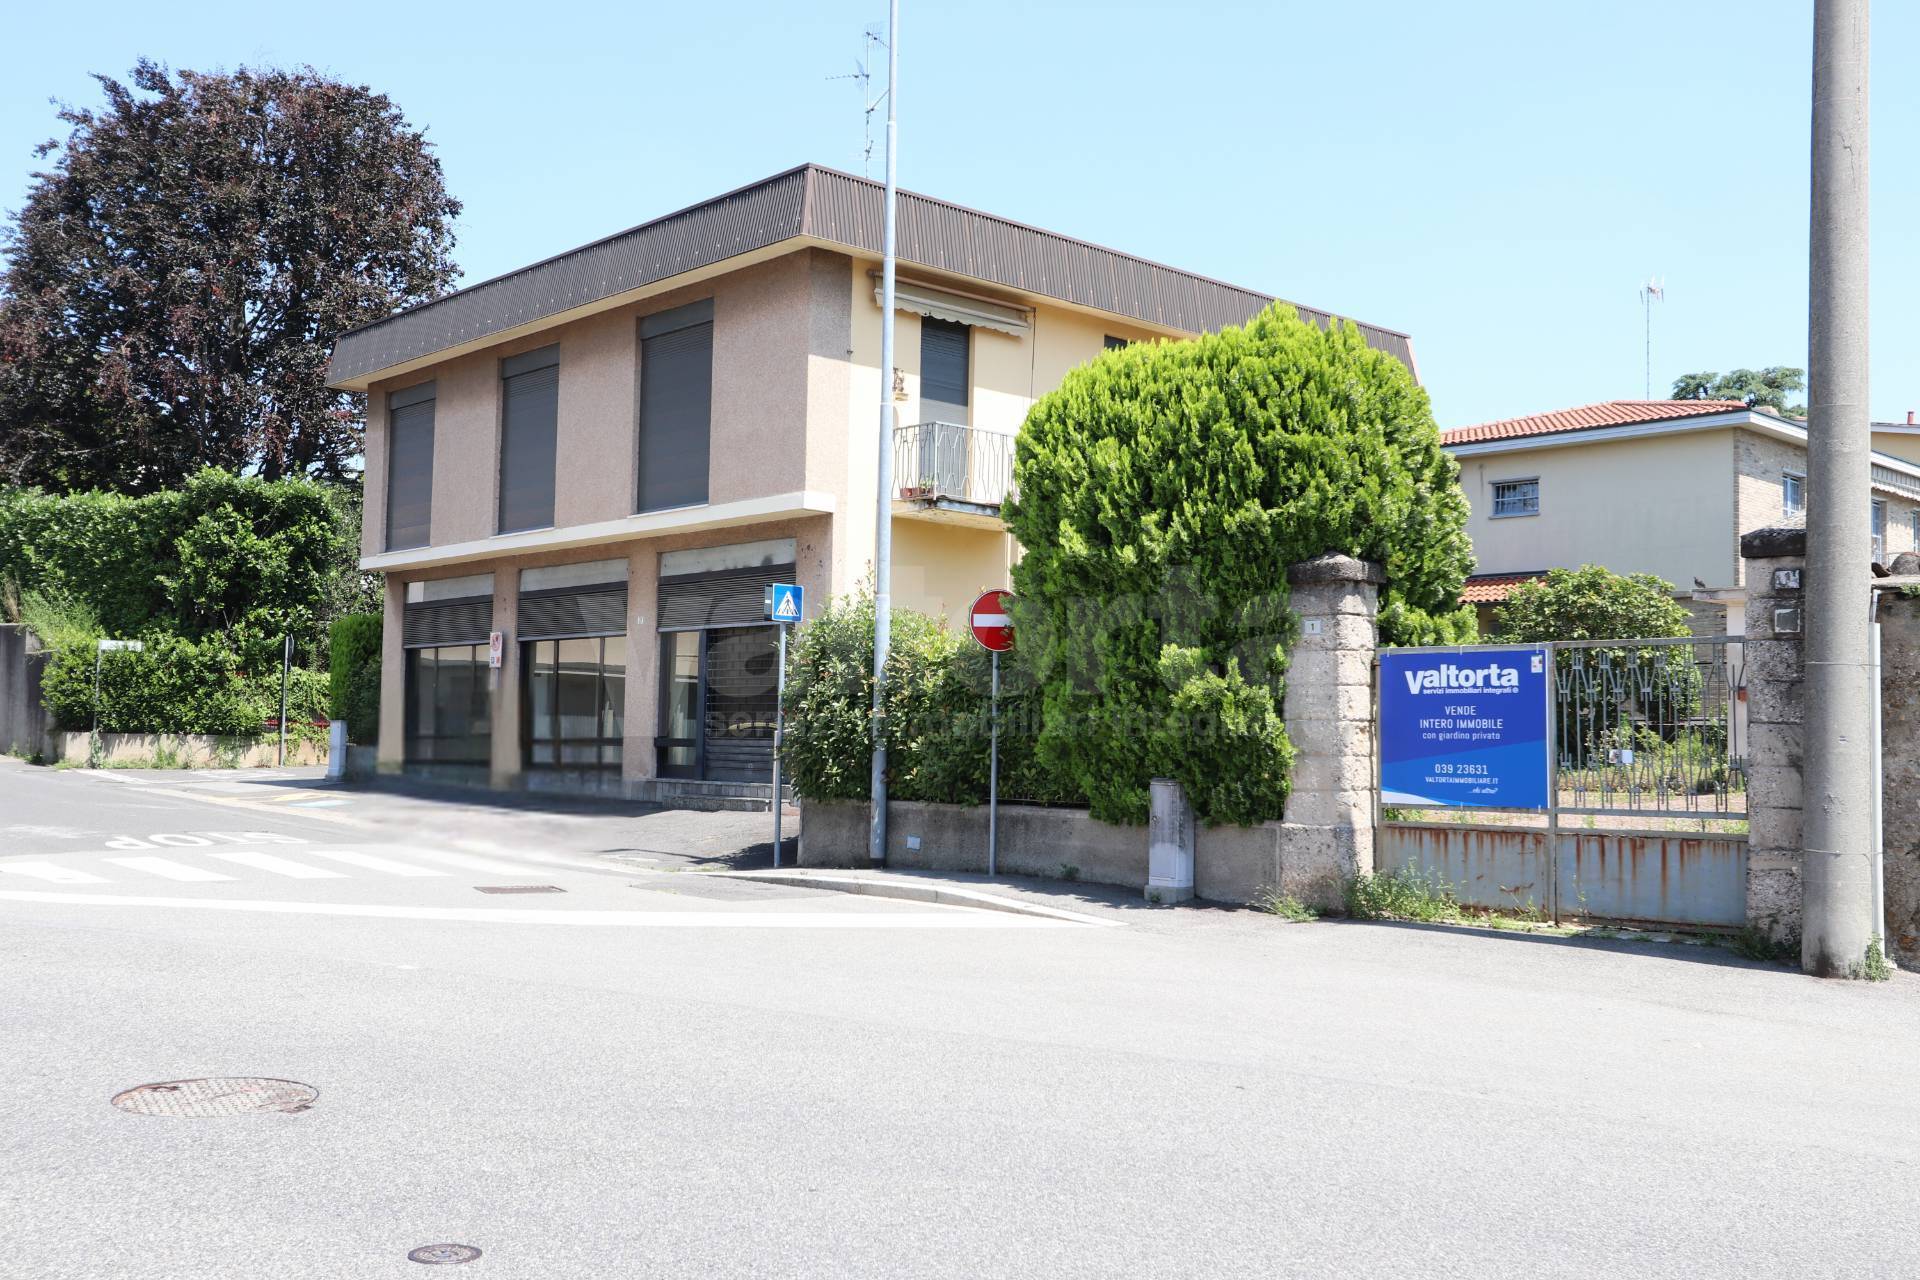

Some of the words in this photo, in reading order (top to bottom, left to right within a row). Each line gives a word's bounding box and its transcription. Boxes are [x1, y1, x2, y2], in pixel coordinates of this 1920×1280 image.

[1404, 663, 1520, 695] valtorta
[1444, 705, 1477, 716] VENDE
[1420, 719, 1453, 729] INTERO
[1456, 719, 1504, 729] IMMOBILE
[1422, 732, 1437, 740] con
[1438, 731, 1470, 741] giardino
[1472, 731, 1501, 741] privato
[1434, 763, 1454, 774] 039
[1456, 764, 1489, 775] 23631
